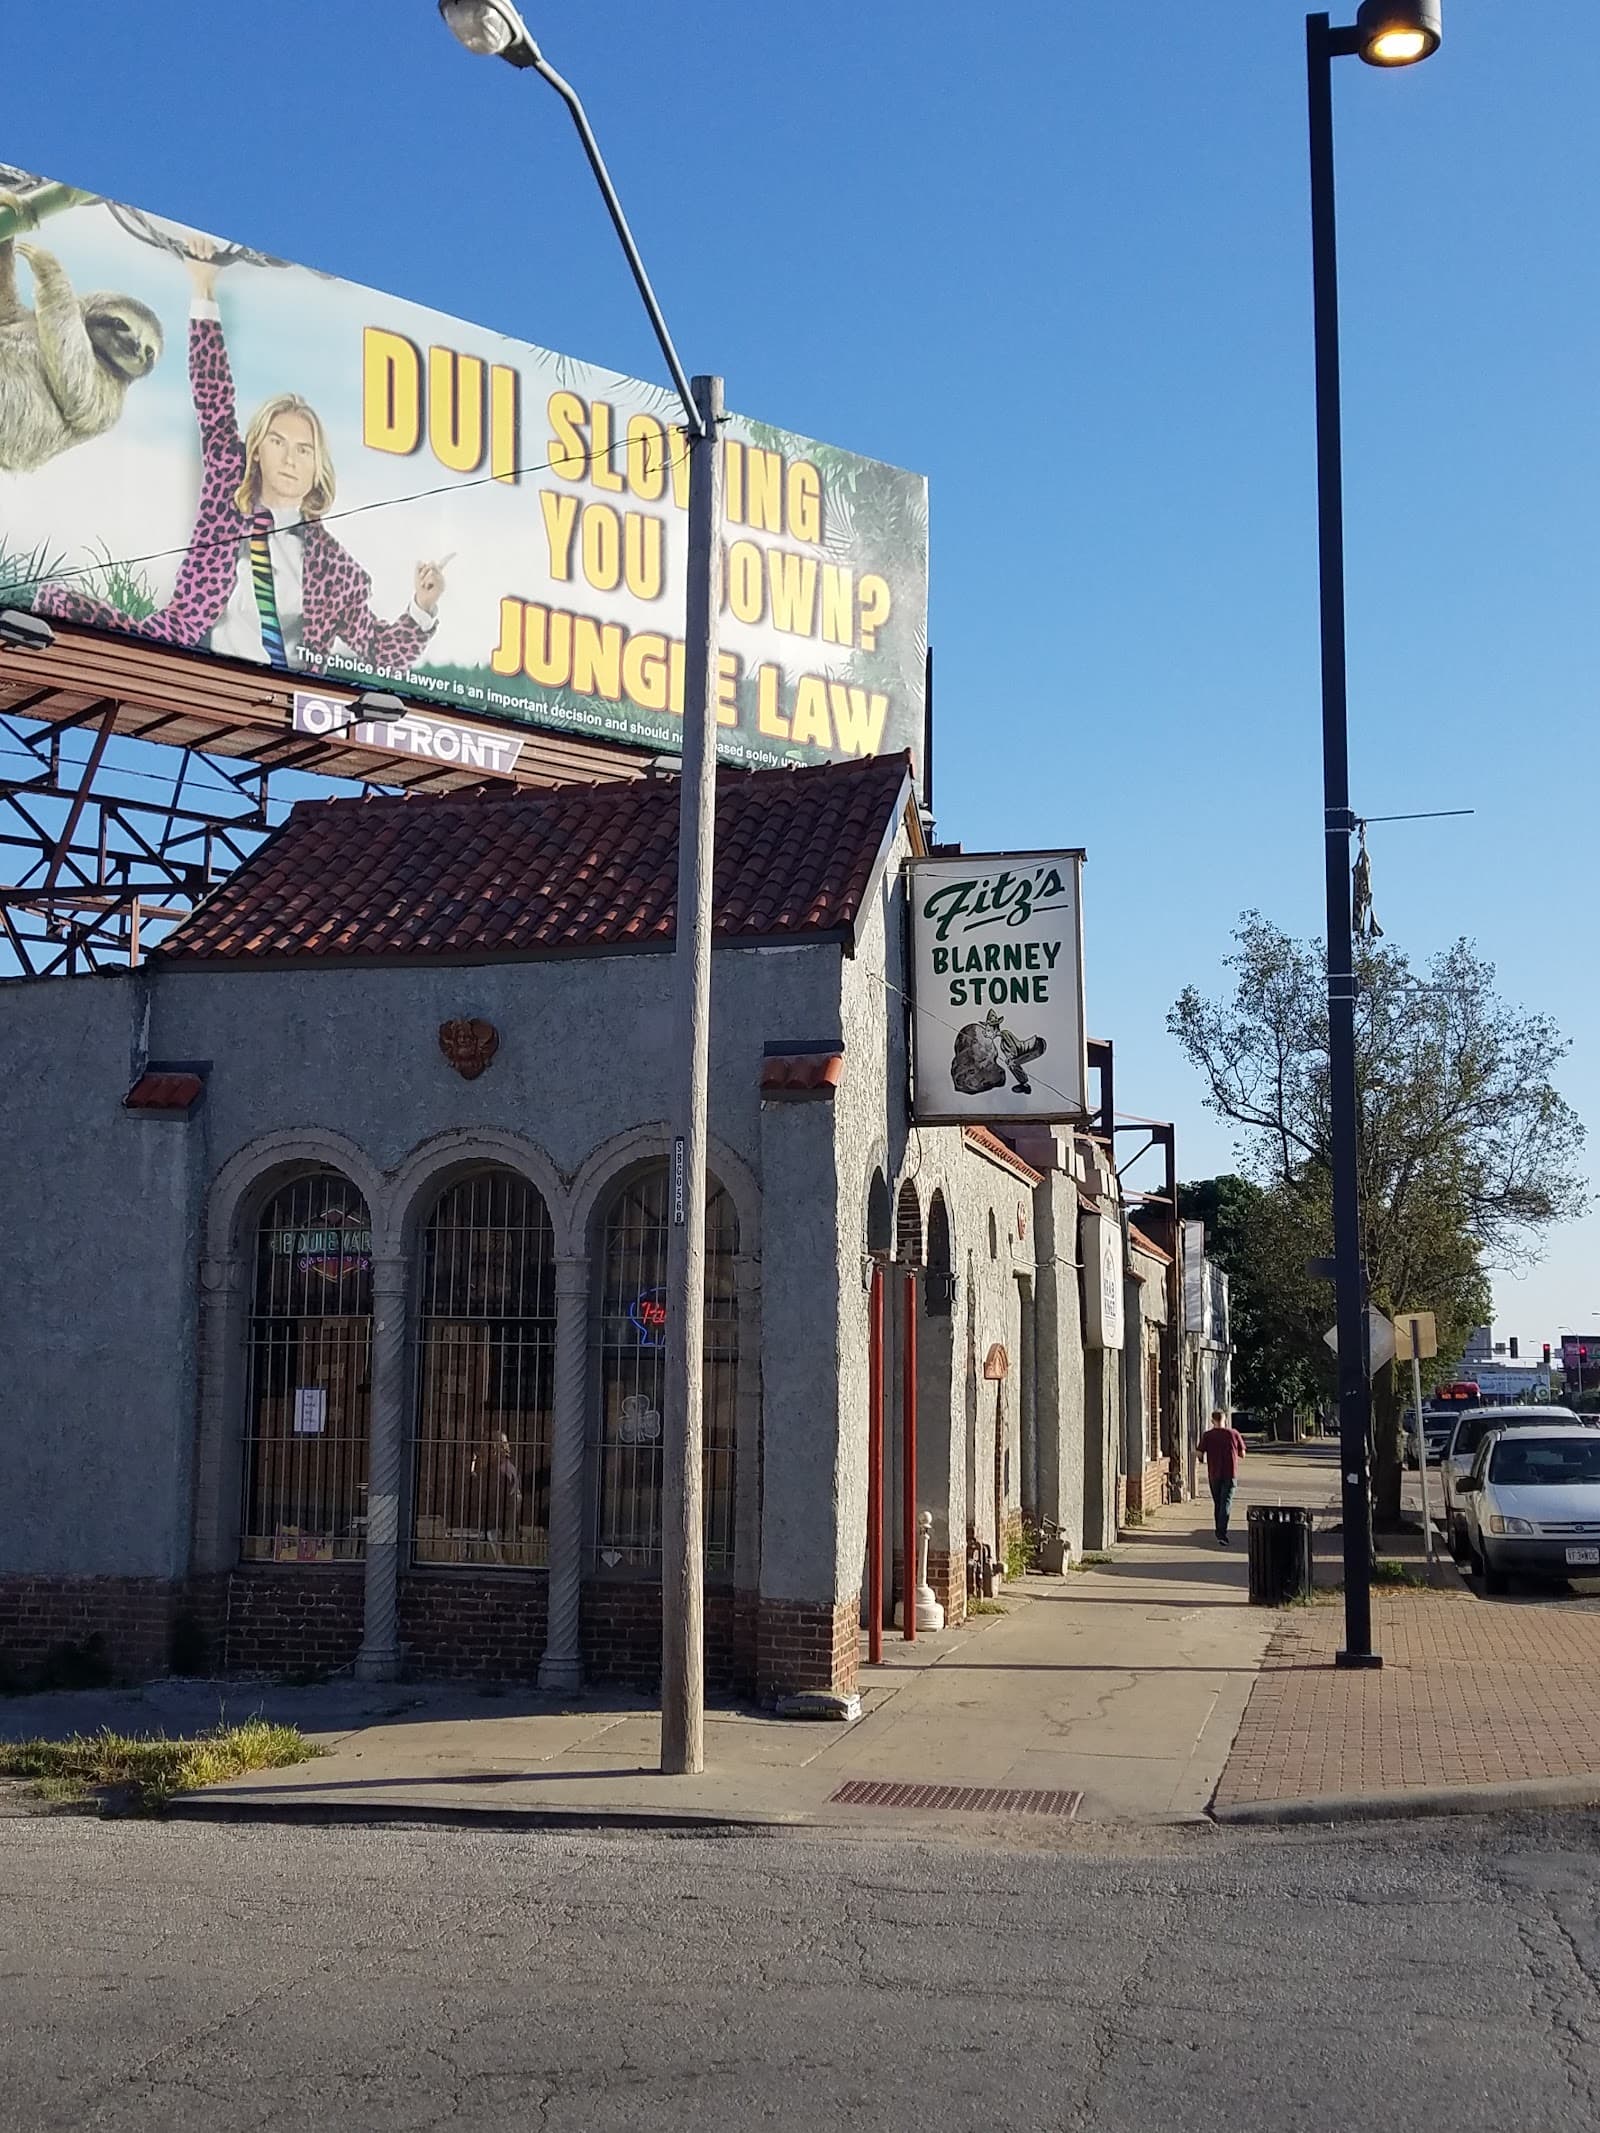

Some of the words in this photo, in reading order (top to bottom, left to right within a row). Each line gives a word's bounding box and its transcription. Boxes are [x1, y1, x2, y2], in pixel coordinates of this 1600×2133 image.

[363, 327, 517, 484] DUI
[540, 490, 663, 600] YOU
[719, 540, 891, 652] OWN?
[296, 646, 323, 664] The
[327, 654, 374, 674] choice
[377, 665, 391, 679] of
[394, 670, 402, 681] a
[406, 669, 450, 691] lawyer
[453, 680, 464, 694] is
[468, 686, 484, 700] an
[487, 688, 549, 714] important
[551, 704, 602, 727] decision
[605, 717, 628, 731] and
[631, 720, 669, 741] should
[715, 743, 744, 758] ased
[746, 746, 779, 767] solely
[758, 664, 889, 757] LAW
[923, 868, 1067, 941] Fitz's
[932, 941, 1062, 974] BLARNEY
[949, 975, 1049, 1006] STONE
